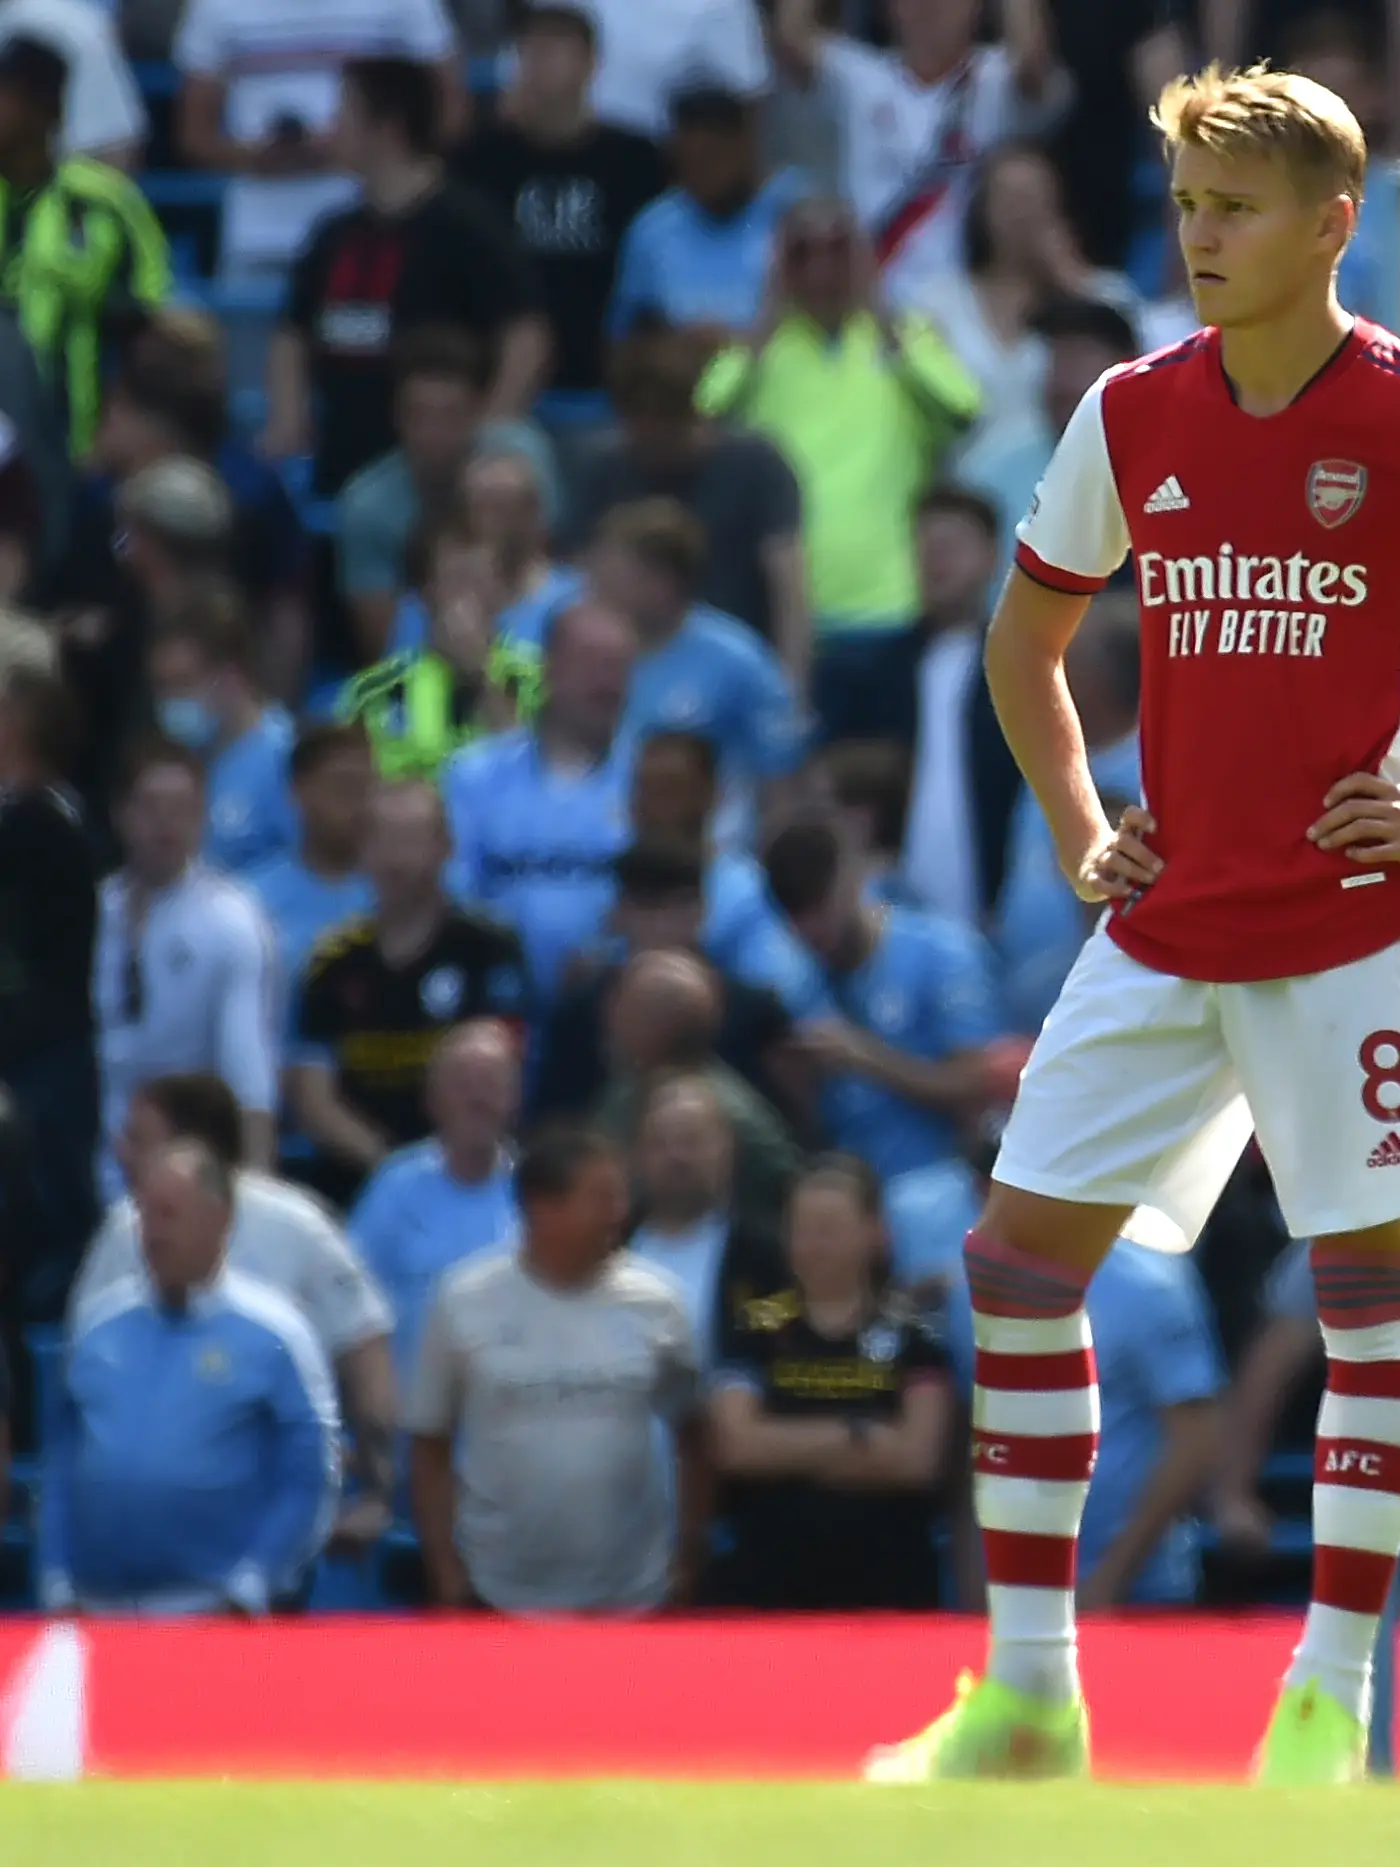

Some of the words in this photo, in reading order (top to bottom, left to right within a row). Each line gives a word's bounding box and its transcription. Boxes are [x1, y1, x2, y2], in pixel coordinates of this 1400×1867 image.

[1138, 541, 1368, 606] Emirates
[1168, 609, 1210, 658] FLY
[1217, 608, 1327, 657] BETTER
[1324, 1448, 1381, 1477] AFC
